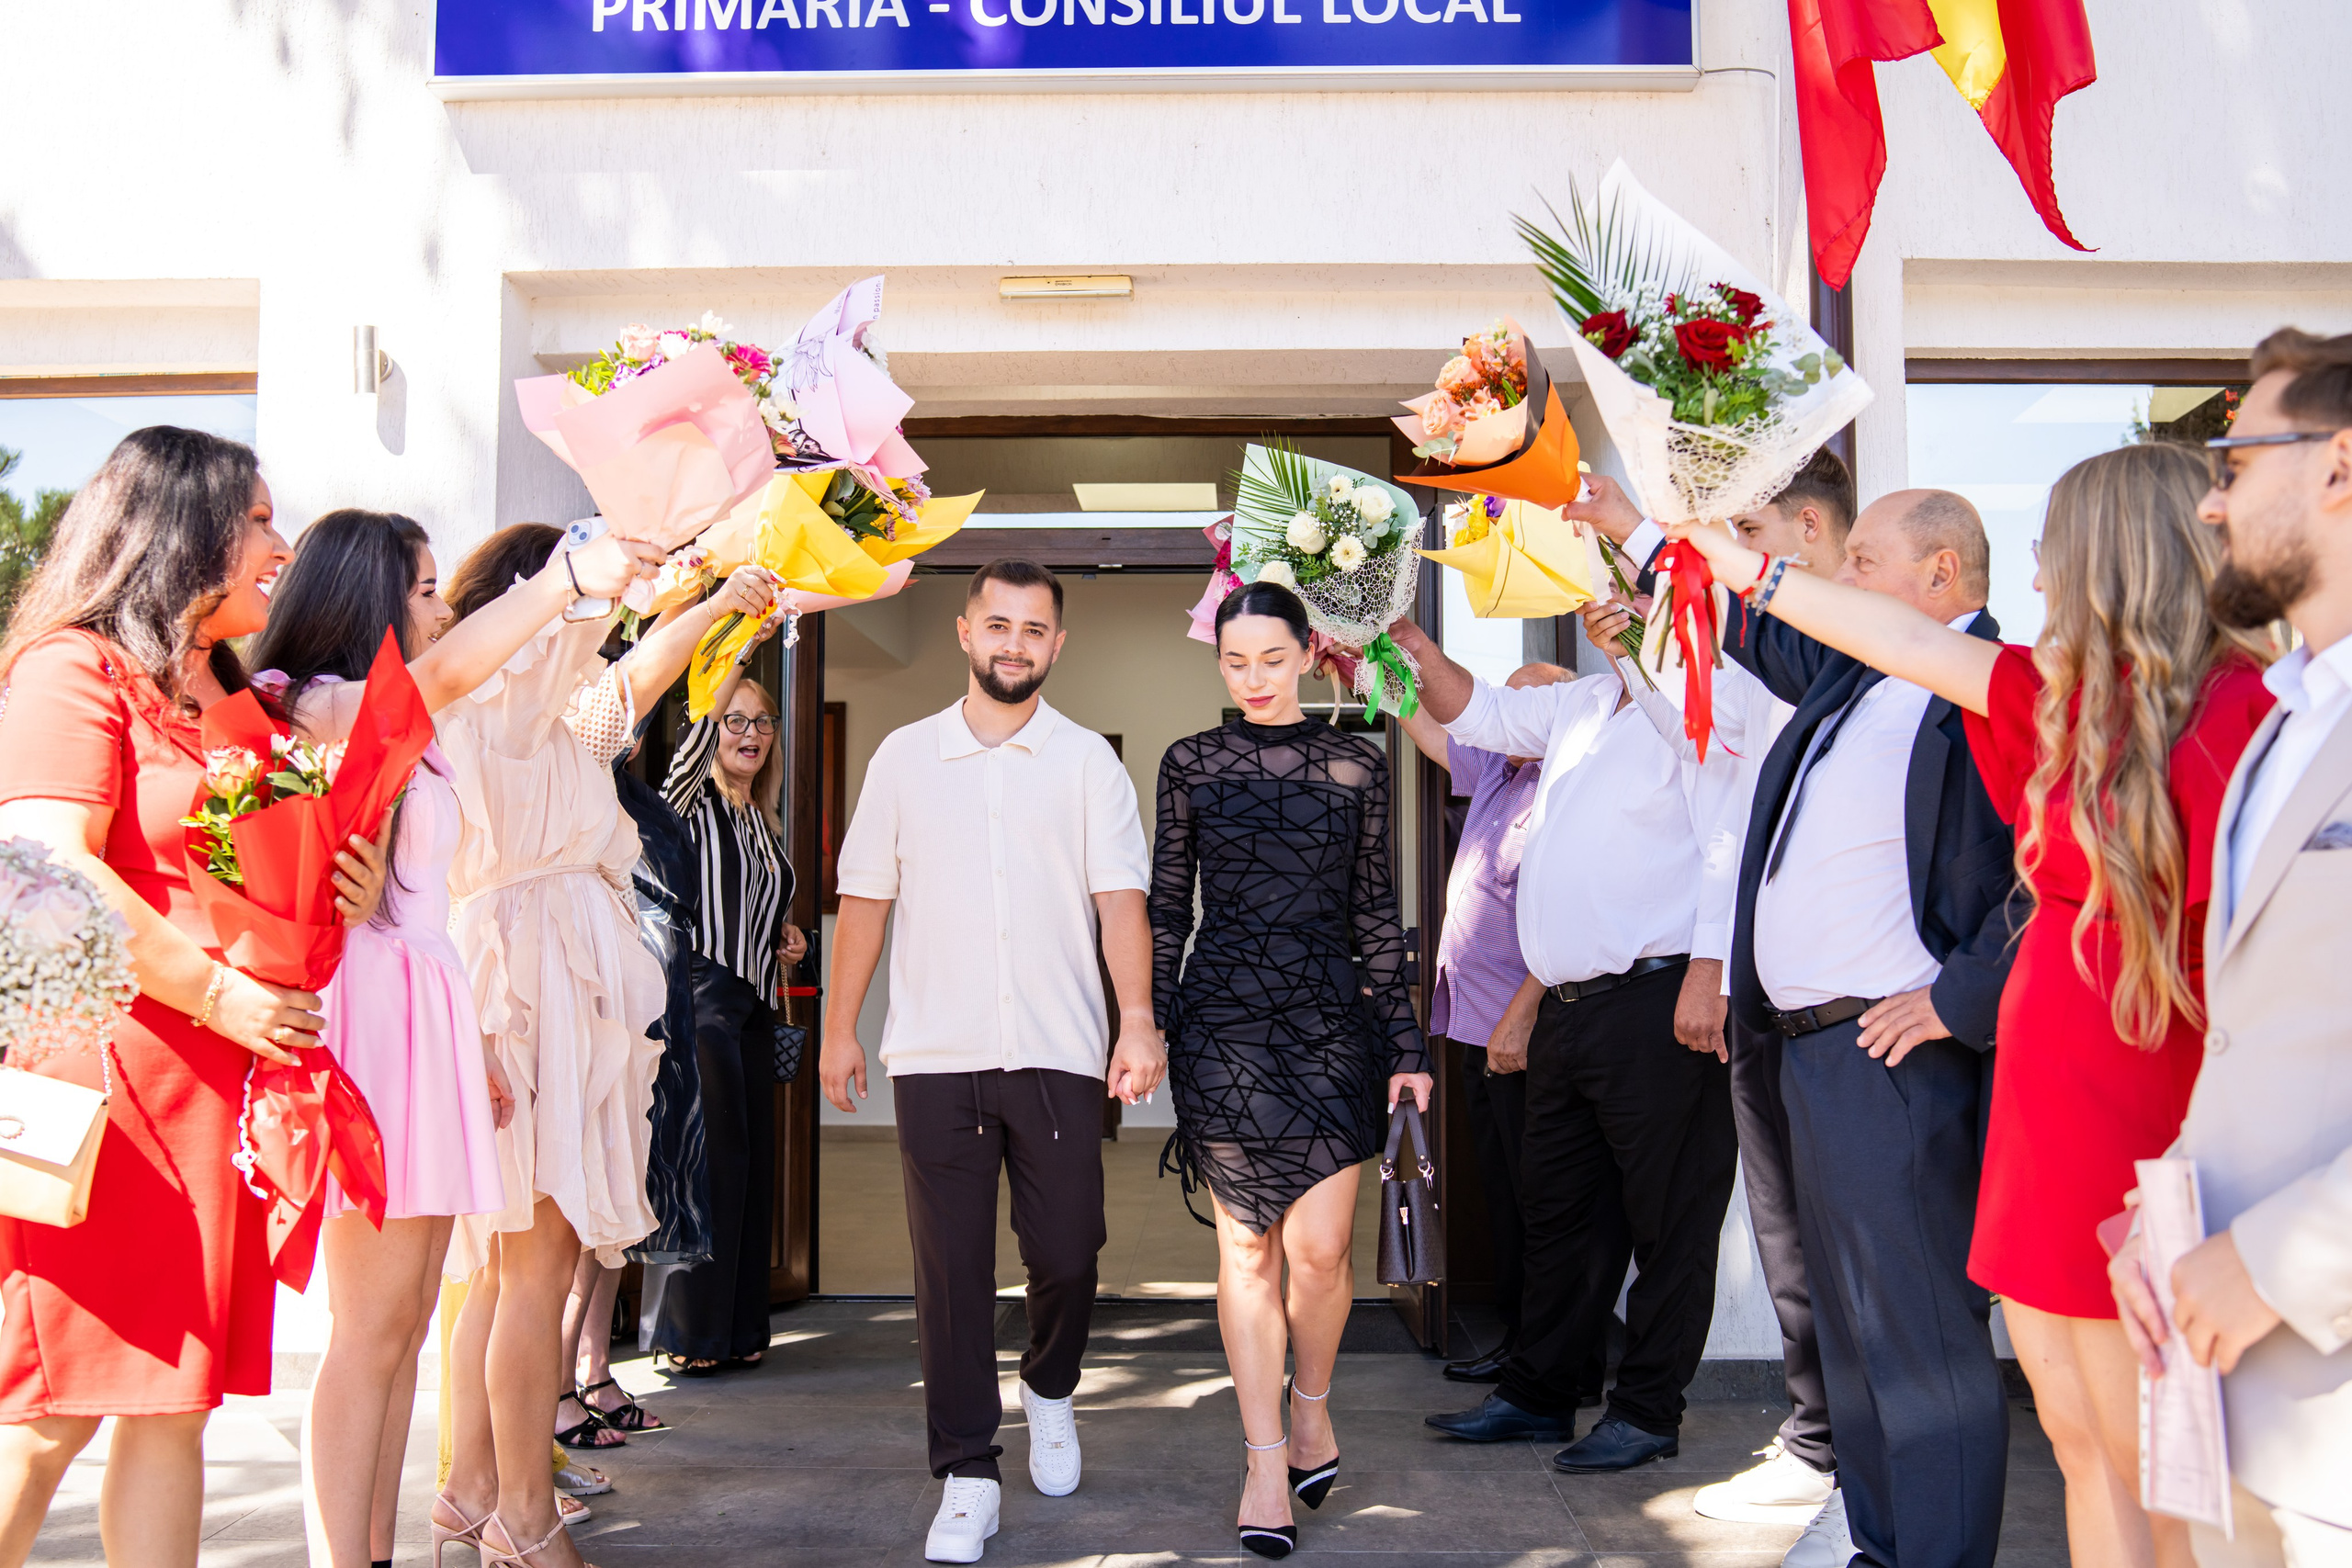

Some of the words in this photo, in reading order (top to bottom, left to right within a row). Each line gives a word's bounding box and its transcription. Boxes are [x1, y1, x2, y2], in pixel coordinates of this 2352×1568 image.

[929, 3, 950, 13] -
[969, 0, 1302, 28] CONSILIUL
[1323, 0, 1521, 24] LOCAL
